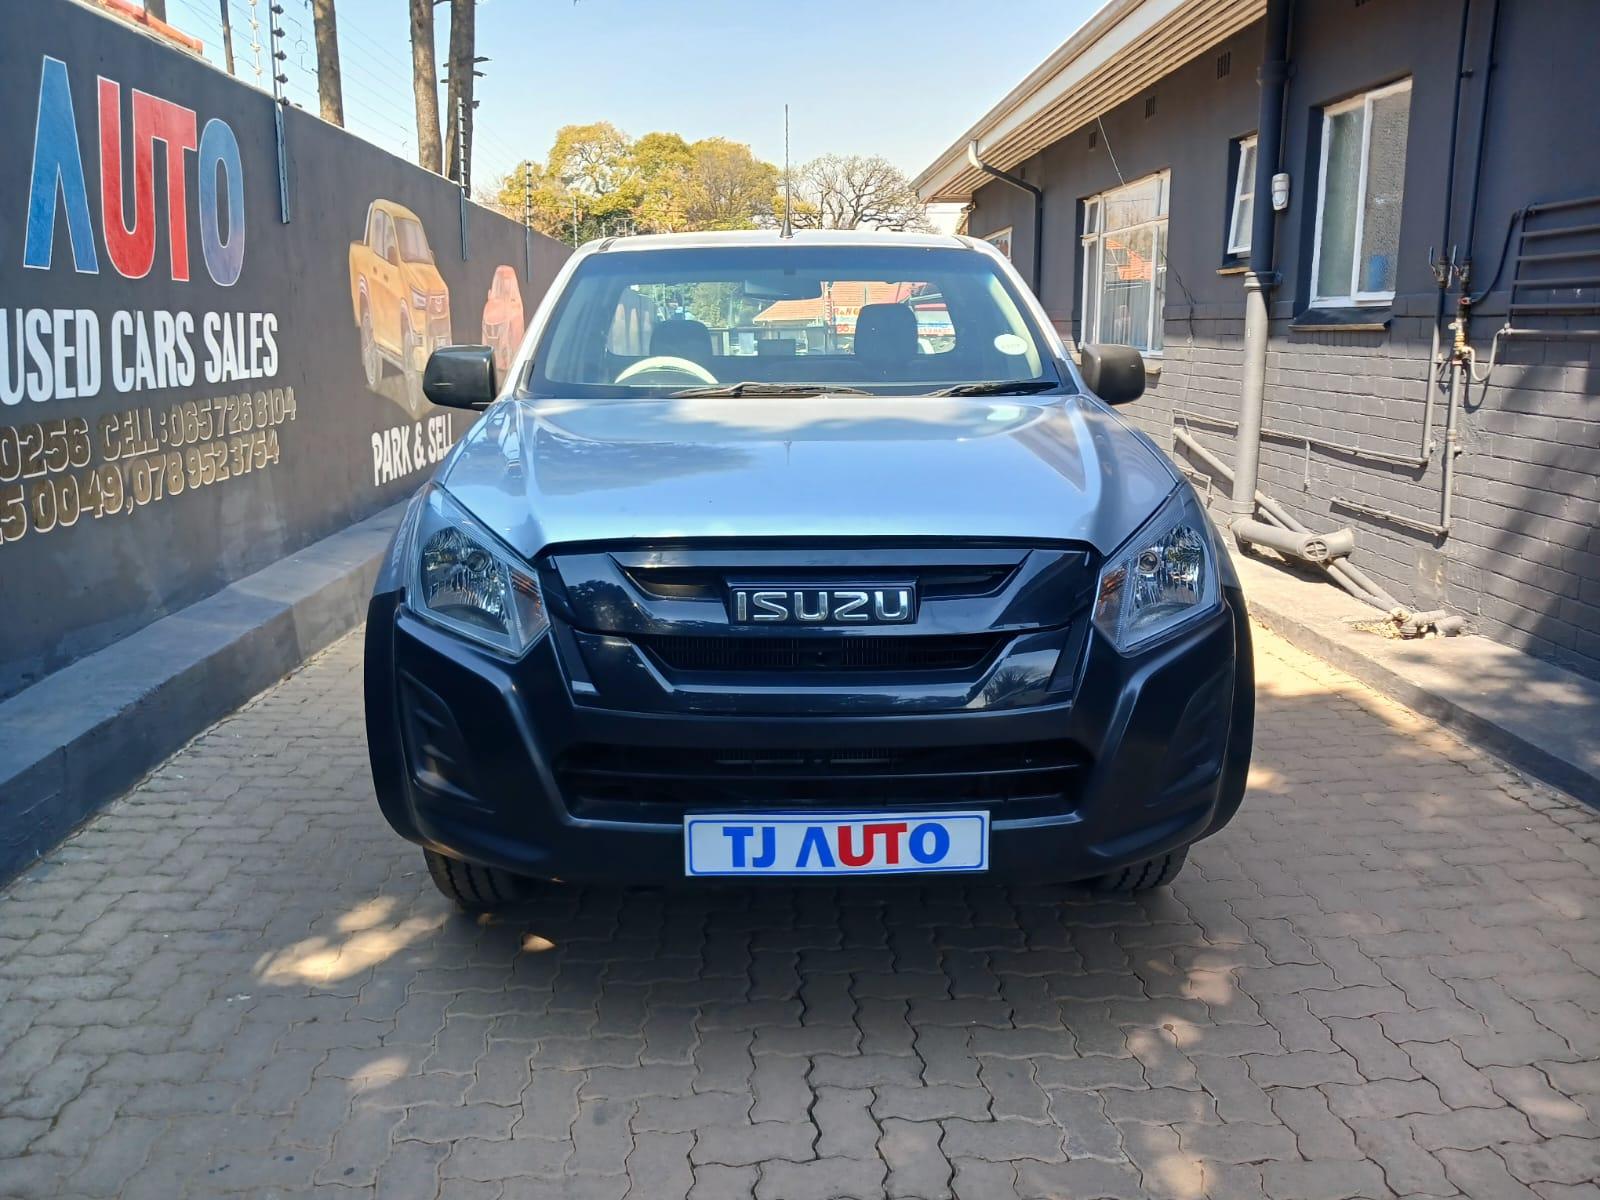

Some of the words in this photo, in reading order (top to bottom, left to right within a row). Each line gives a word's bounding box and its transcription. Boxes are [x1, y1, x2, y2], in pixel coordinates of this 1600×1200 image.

[23, 54, 245, 288] AUTO
[0, 308, 102, 406] USED
[111, 310, 196, 393] CARS
[203, 311, 279, 383] SALES
[0, 417, 91, 482] 0256
[371, 424, 413, 487] PARK
[414, 421, 427, 470] &
[735, 590, 910, 622] ISUZU
[722, 825, 777, 868] TJ
[795, 822, 950, 868] AUTO
